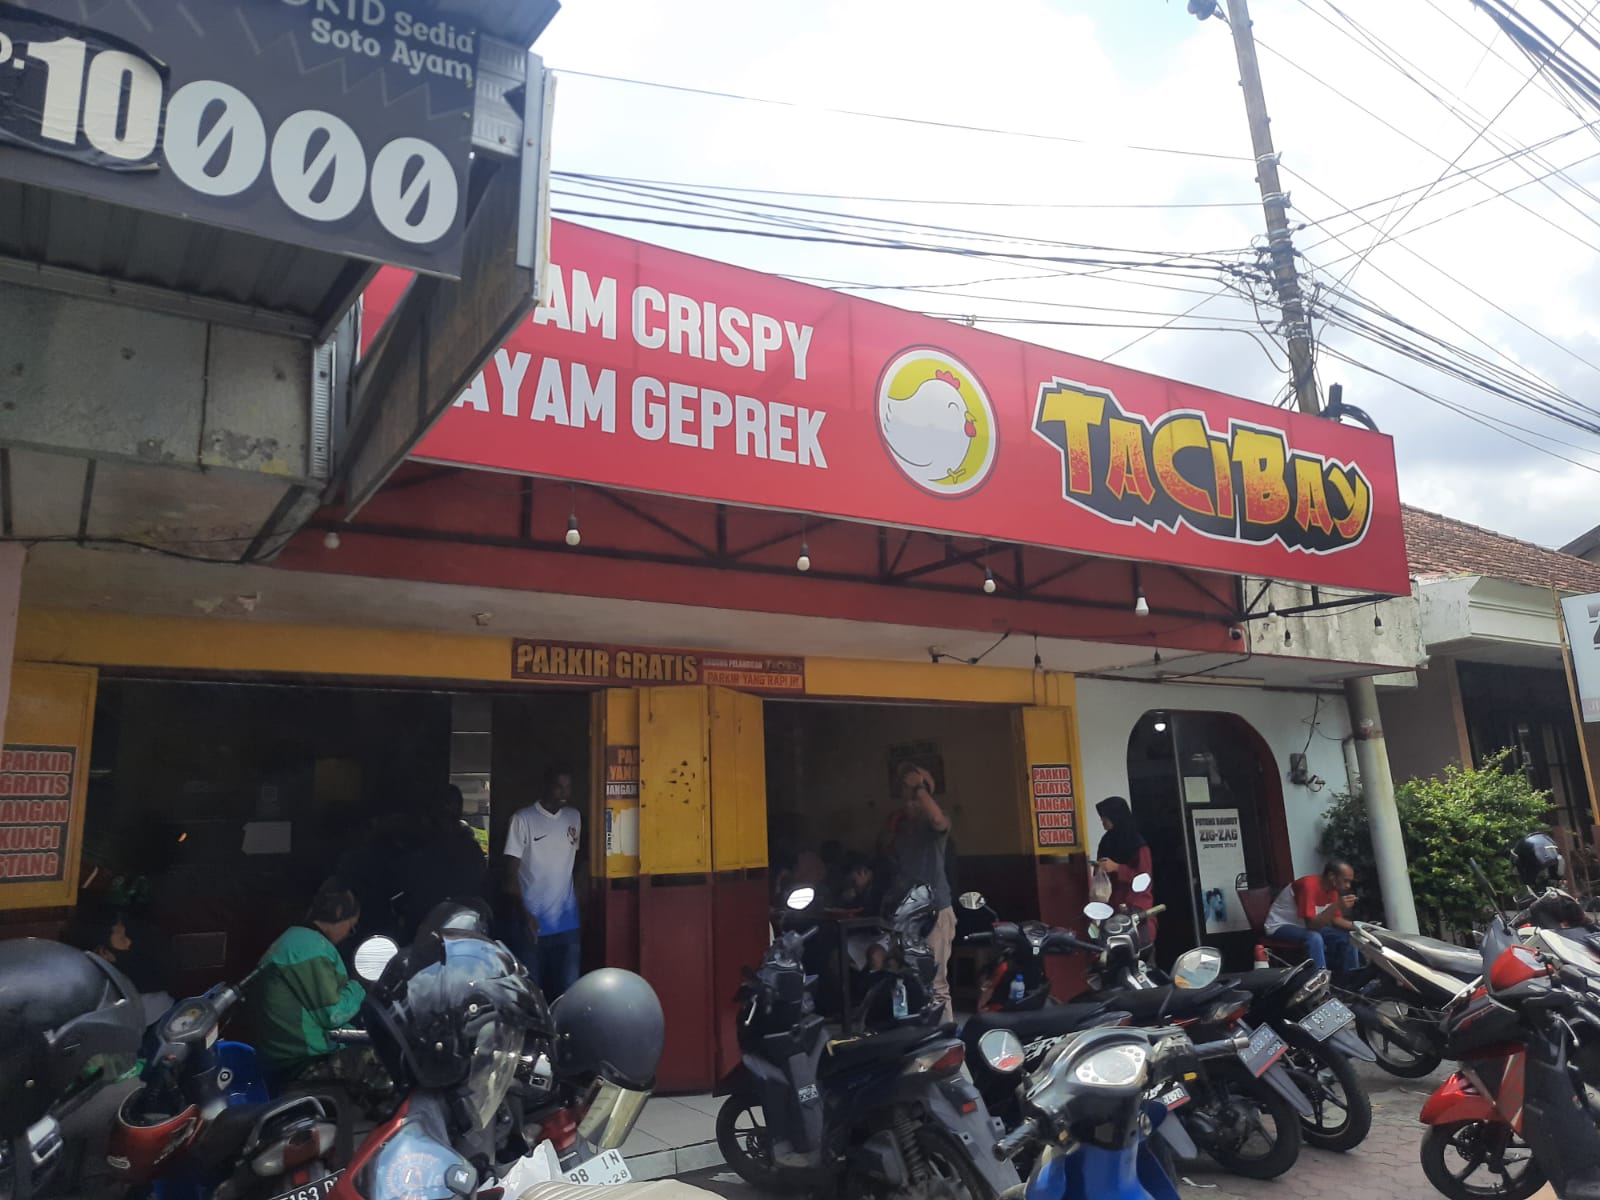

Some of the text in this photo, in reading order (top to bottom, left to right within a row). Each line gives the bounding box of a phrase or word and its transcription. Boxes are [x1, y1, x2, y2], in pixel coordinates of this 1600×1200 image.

[394, 11, 474, 53] Sedia
[311, 18, 474, 81] Soto Ayam
[631, 285, 814, 381] CRISPY
[631, 376, 828, 468] GEPREK
[516, 645, 699, 682] PARKIR GRATIS
[1, 752, 71, 772] PARKIR
[0, 774, 68, 794] GRATIS
[1032, 768, 1069, 780] PARKIR
[1035, 782, 1071, 794] GRATIS
[0, 800, 68, 822] ANGAN
[1035, 797, 1073, 811] JANGAN
[1039, 813, 1072, 827] KUNCI
[1040, 829, 1073, 844] STANG
[1200, 829, 1238, 841] ZIG-ZAG
